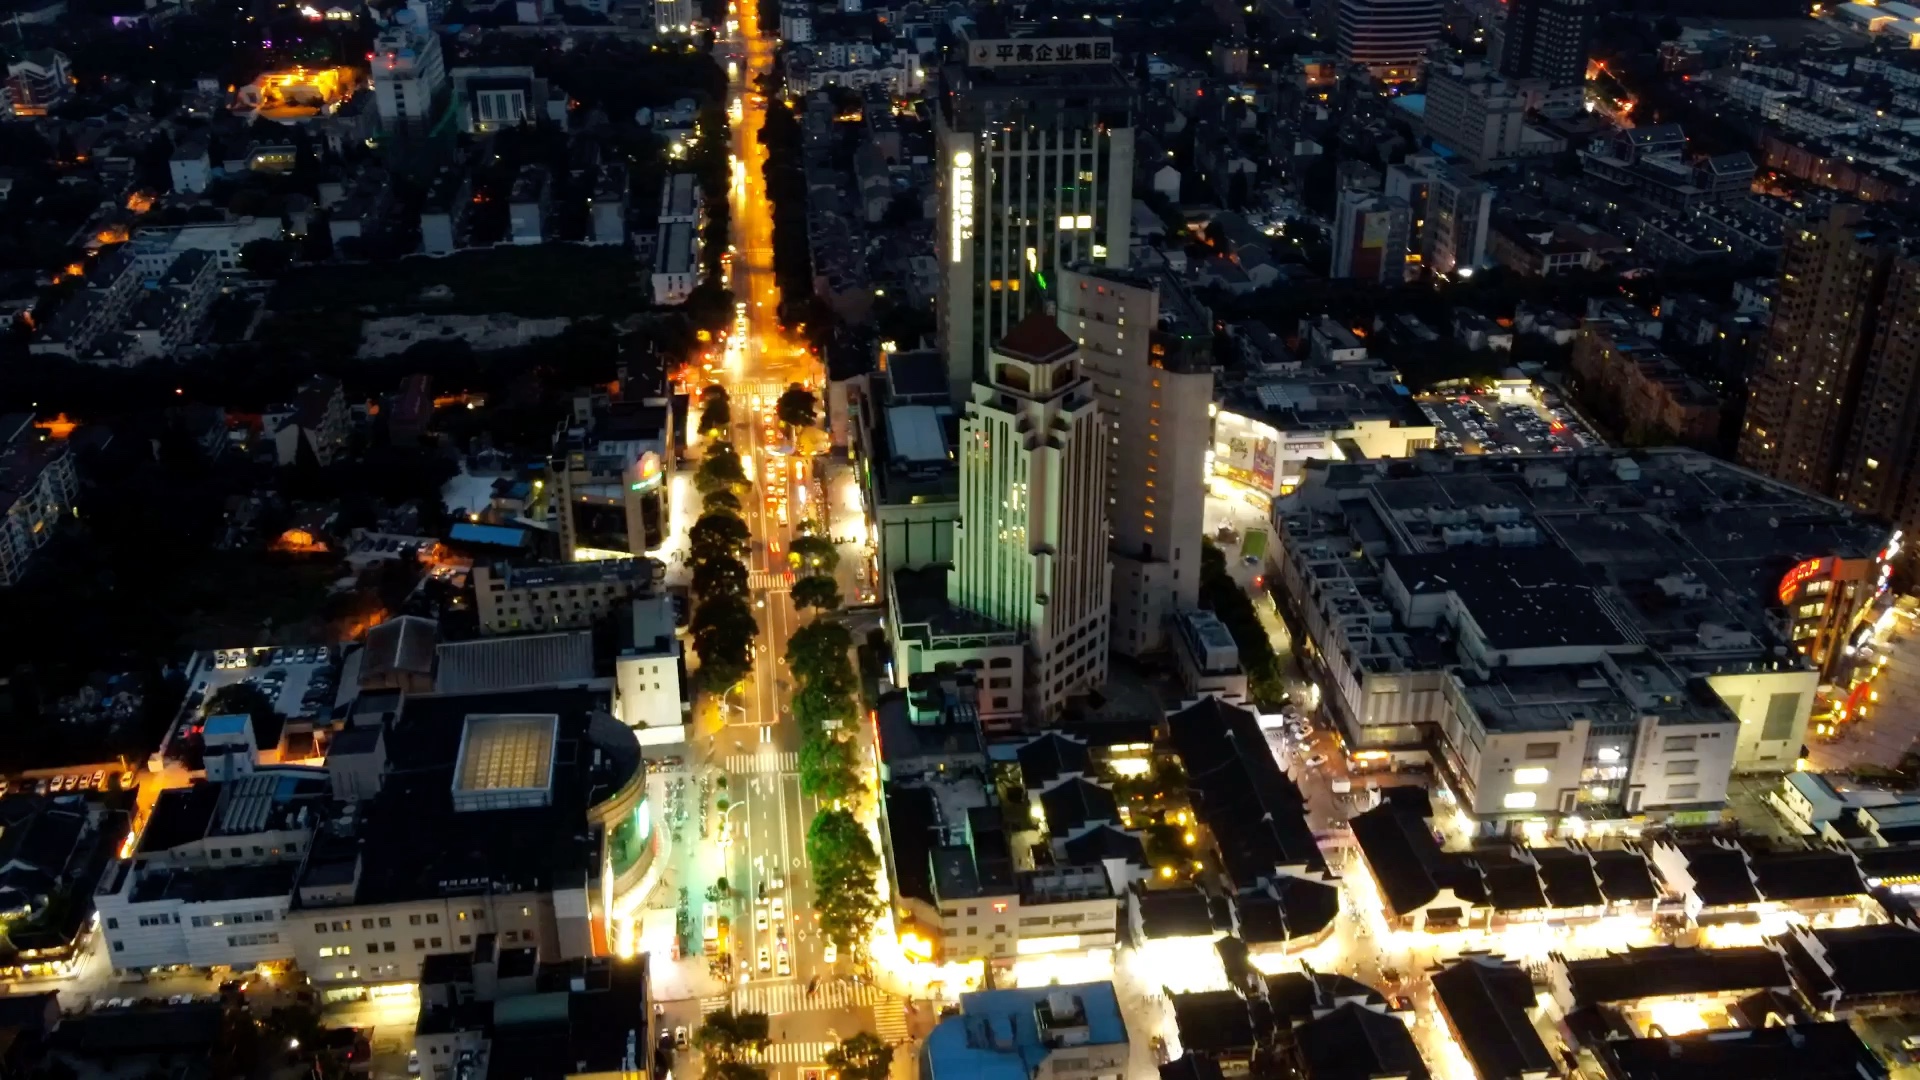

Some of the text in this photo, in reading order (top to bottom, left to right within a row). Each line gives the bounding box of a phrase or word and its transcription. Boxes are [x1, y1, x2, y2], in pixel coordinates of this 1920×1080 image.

[996, 42, 1111, 62] 平高企业集团
